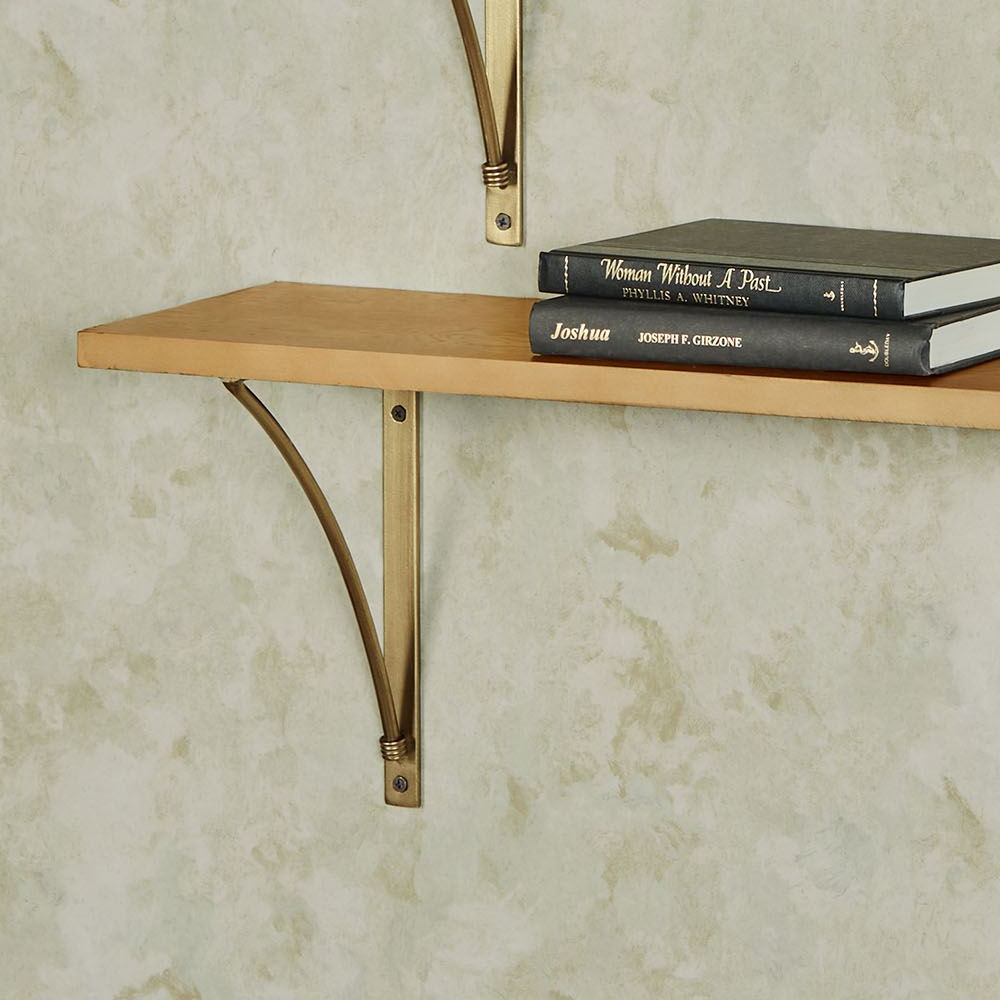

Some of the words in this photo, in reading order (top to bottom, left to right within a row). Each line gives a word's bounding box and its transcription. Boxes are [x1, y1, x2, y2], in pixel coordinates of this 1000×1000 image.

[600, 258, 652, 283] Woman
[656, 262, 713, 287] Without
[716, 267, 736, 289] A
[737, 269, 782, 293] Past
[622, 287, 671, 301] PHYLLIS
[677, 292, 688, 302] A.
[692, 292, 749, 307] WHITNEY
[551, 322, 611, 342] Joshua
[637, 331, 680, 345] JOSEPH
[681, 334, 691, 345] F.
[692, 334, 742, 348] GIRZONE
